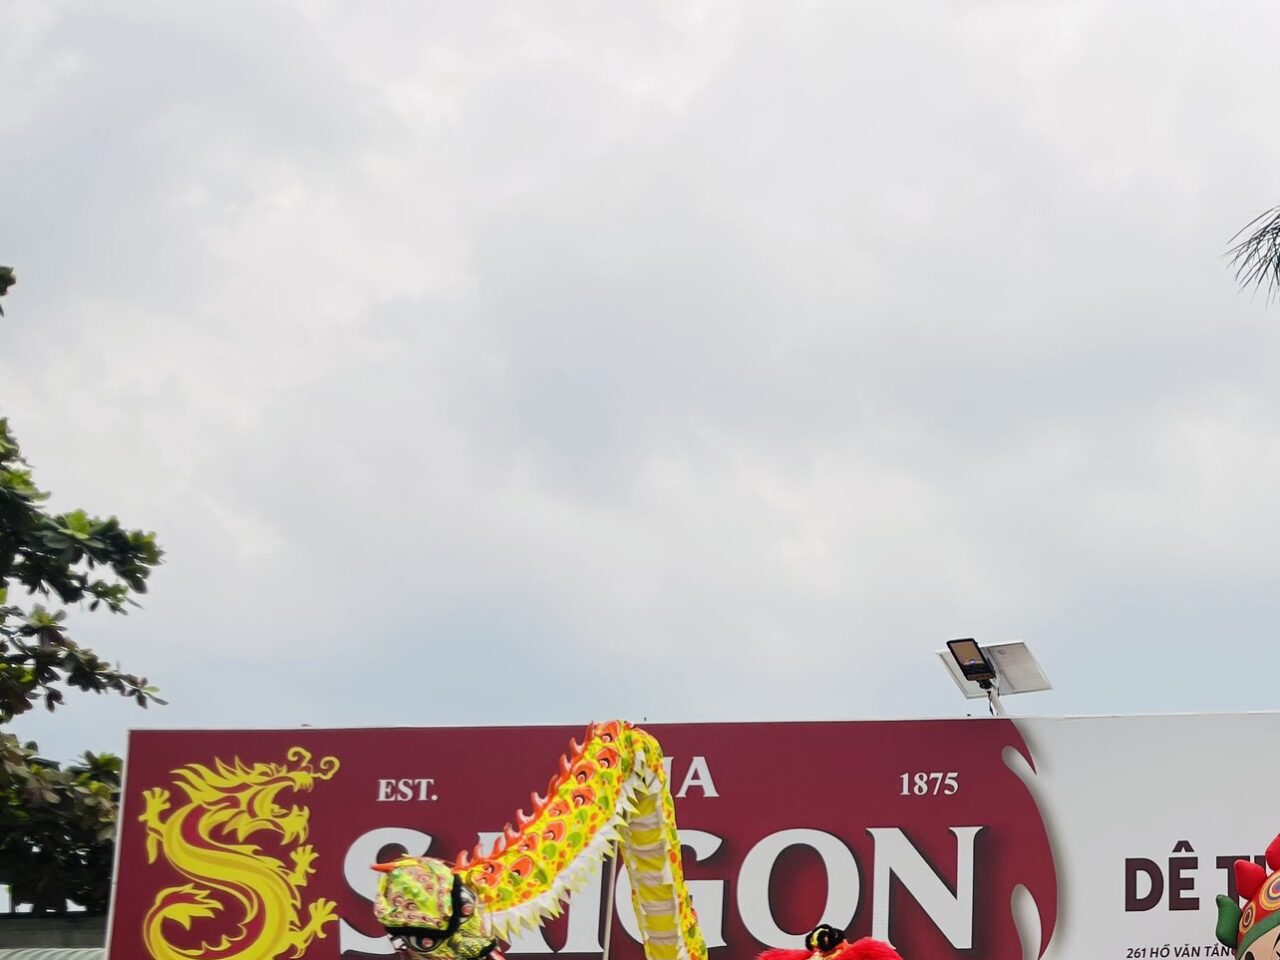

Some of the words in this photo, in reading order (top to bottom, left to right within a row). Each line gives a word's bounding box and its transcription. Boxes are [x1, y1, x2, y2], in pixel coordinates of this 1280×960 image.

[376, 778, 438, 802] EST.
[900, 772, 959, 796] 1875
[1125, 840, 1200, 912] DÊ
[1126, 947, 1146, 959] 261
[1174, 943, 1201, 958] VĂN
